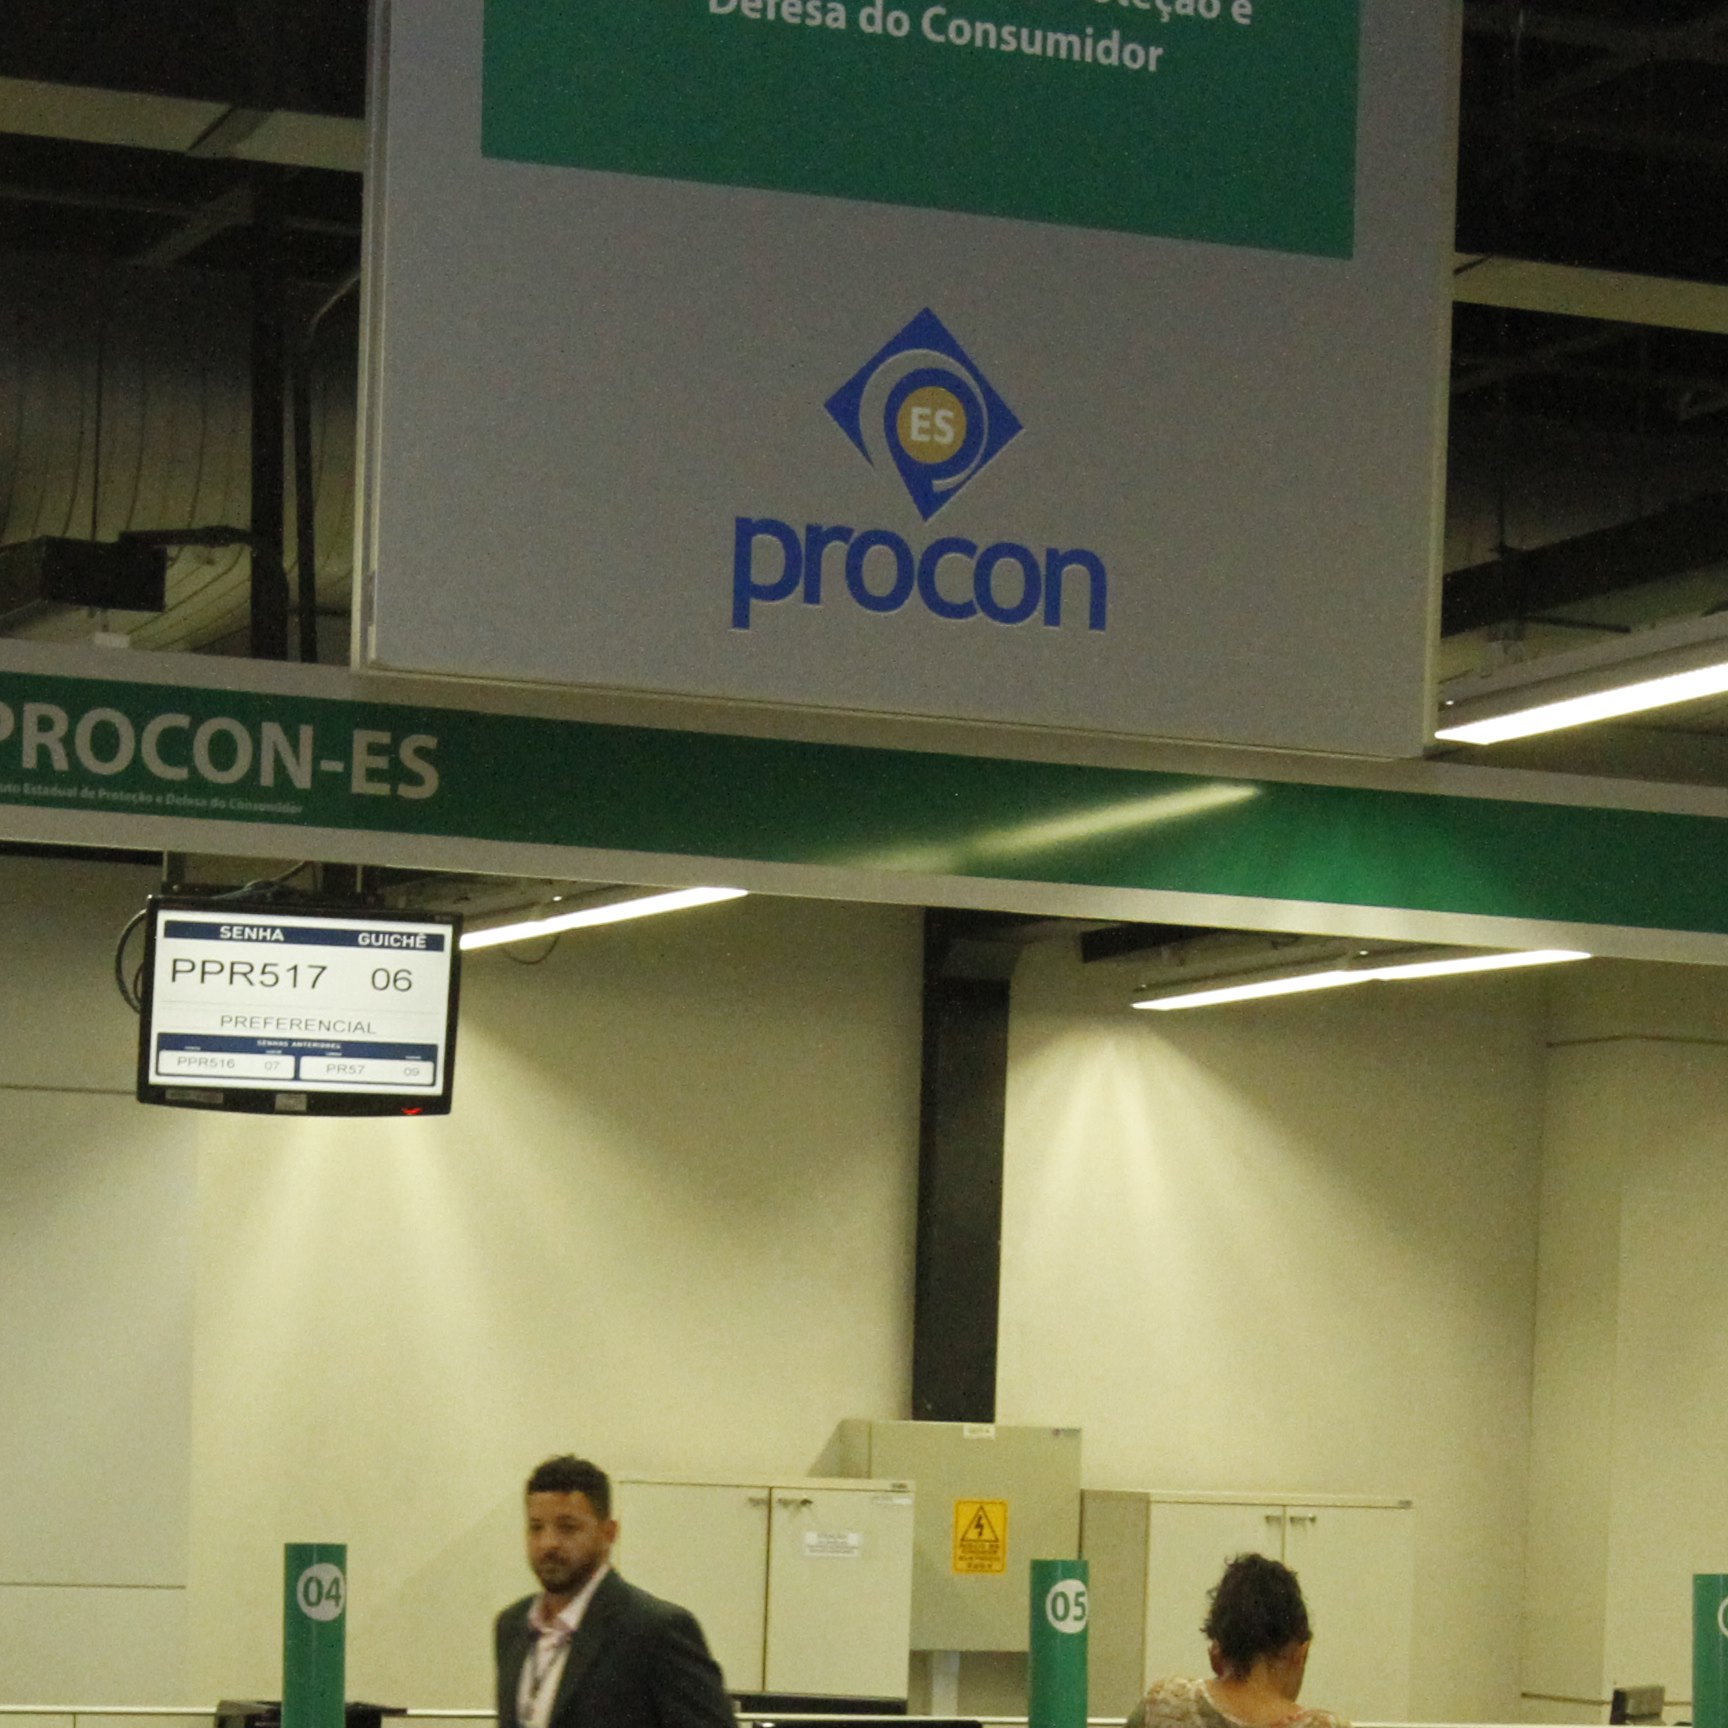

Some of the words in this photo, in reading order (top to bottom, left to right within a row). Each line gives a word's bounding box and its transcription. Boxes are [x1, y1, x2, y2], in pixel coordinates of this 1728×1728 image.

[858, 0, 911, 37] do
[921, 6, 1164, 72] Consumidor
[910, 405, 955, 445] ES
[731, 516, 1108, 631] procon
[219, 925, 285, 942] SENHA
[357, 932, 428, 949] GUICHÊ
[171, 957, 328, 989] PPR517
[371, 967, 413, 992] 06
[220, 1014, 377, 1034] PREFERENCIAL
[177, 1056, 235, 1069] PPR516
[264, 1061, 281, 1072] 07
[403, 1067, 420, 1077] 09
[302, 1575, 342, 1609] 04
[1049, 1590, 1088, 1622] 05
